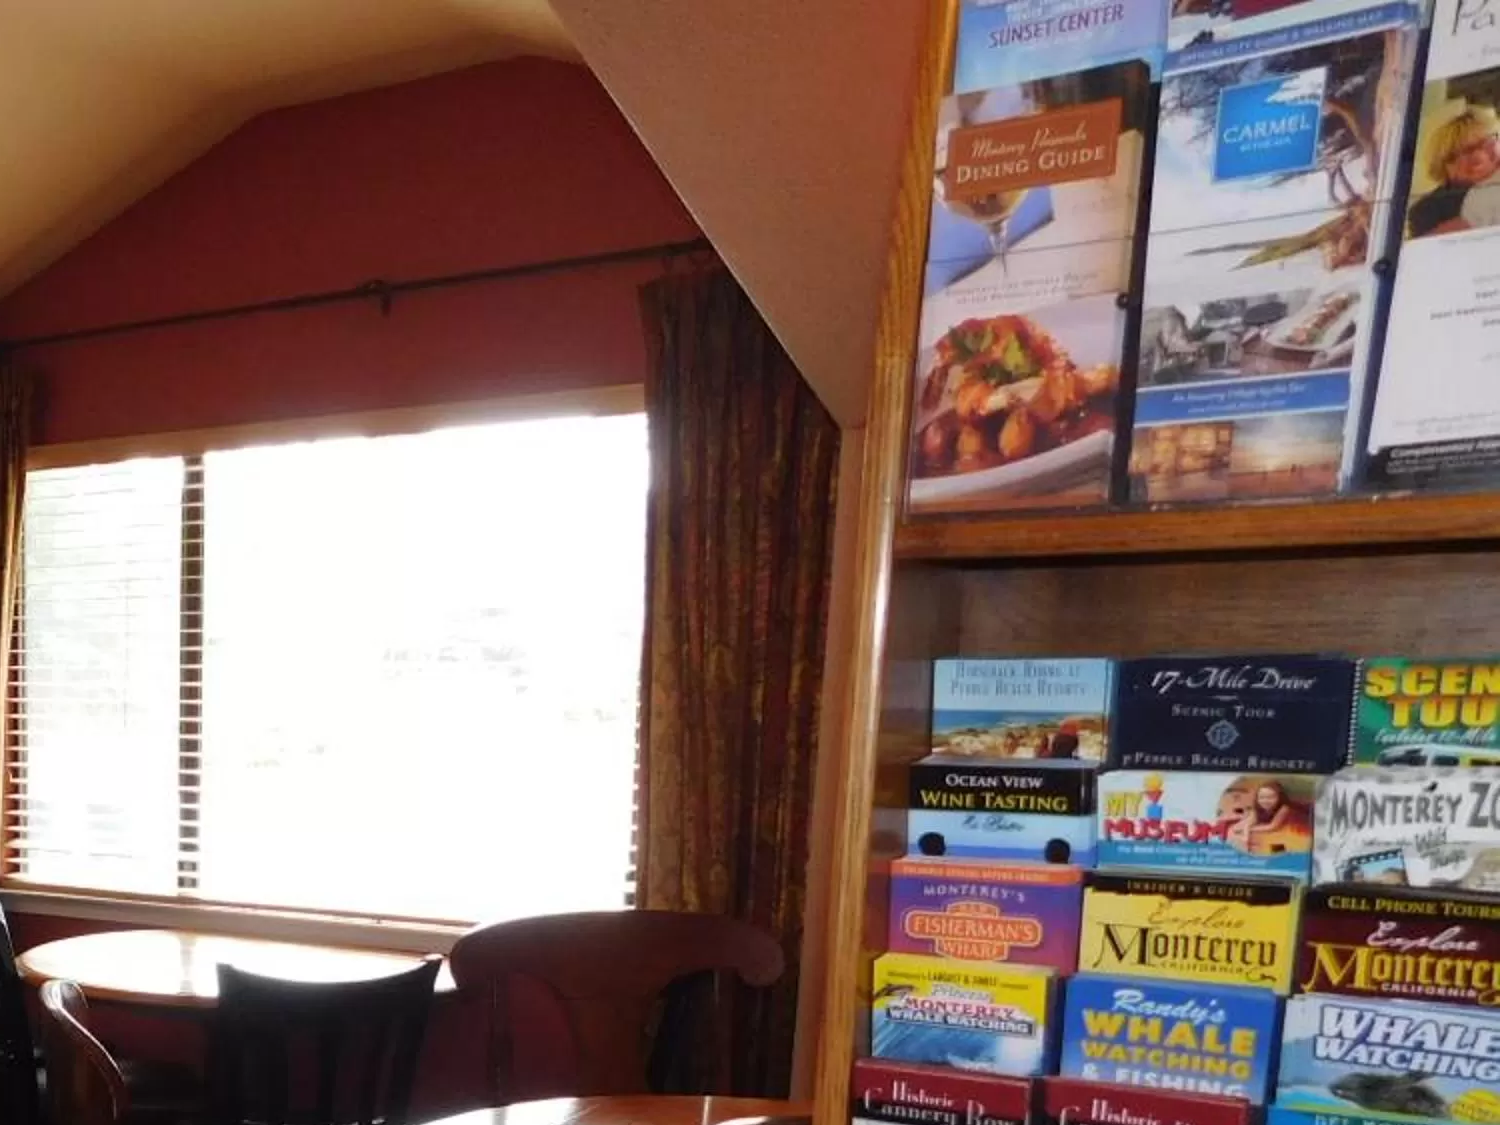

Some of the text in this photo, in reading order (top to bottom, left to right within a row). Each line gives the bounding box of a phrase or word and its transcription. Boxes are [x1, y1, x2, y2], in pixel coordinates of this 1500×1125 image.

[987, 19, 1053, 49] SUNSET
[1057, 3, 1126, 33] CENTER
[1223, 115, 1312, 144] CARMEL
[956, 146, 1106, 184] DINING GUIDE
[1151, 665, 1316, 695] 17-Mile Drive
[1171, 704, 1276, 719] SCENIC TOUR
[946, 773, 1043, 789] OCEAN VIEW
[920, 790, 1069, 812] WINE TASTING
[1105, 791, 1143, 818] MY
[1329, 783, 1463, 837] MONTEREY
[1103, 817, 1231, 846] MUSEUM
[923, 882, 1026, 904] MONTEREY'S
[1207, 885, 1253, 897] GUIDE
[1327, 895, 1370, 911] CELL
[1374, 897, 1438, 915] PHONE
[913, 915, 1034, 941] FISHERMAN'S
[1148, 900, 1245, 930] Explore
[943, 940, 1001, 959] WHARF
[1092, 921, 1278, 980] Monterey
[1366, 919, 1481, 955] Explore
[1159, 960, 1244, 975] CALIFORNIA
[1381, 982, 1478, 999] CALIFORNIA
[905, 997, 1016, 1020] MONTEREY
[1111, 988, 1227, 1024] Randy's
[889, 1008, 1029, 1034] WHALE WATCHING
[1082, 1007, 1258, 1058] WHALE
[1320, 1004, 1500, 1057] WHALE
[1081, 1039, 1251, 1082] WATCHING
[1314, 1036, 1500, 1081] WATCHING
[892, 1079, 954, 1107] Historic
[1082, 1062, 1248, 1098] & FISHING
